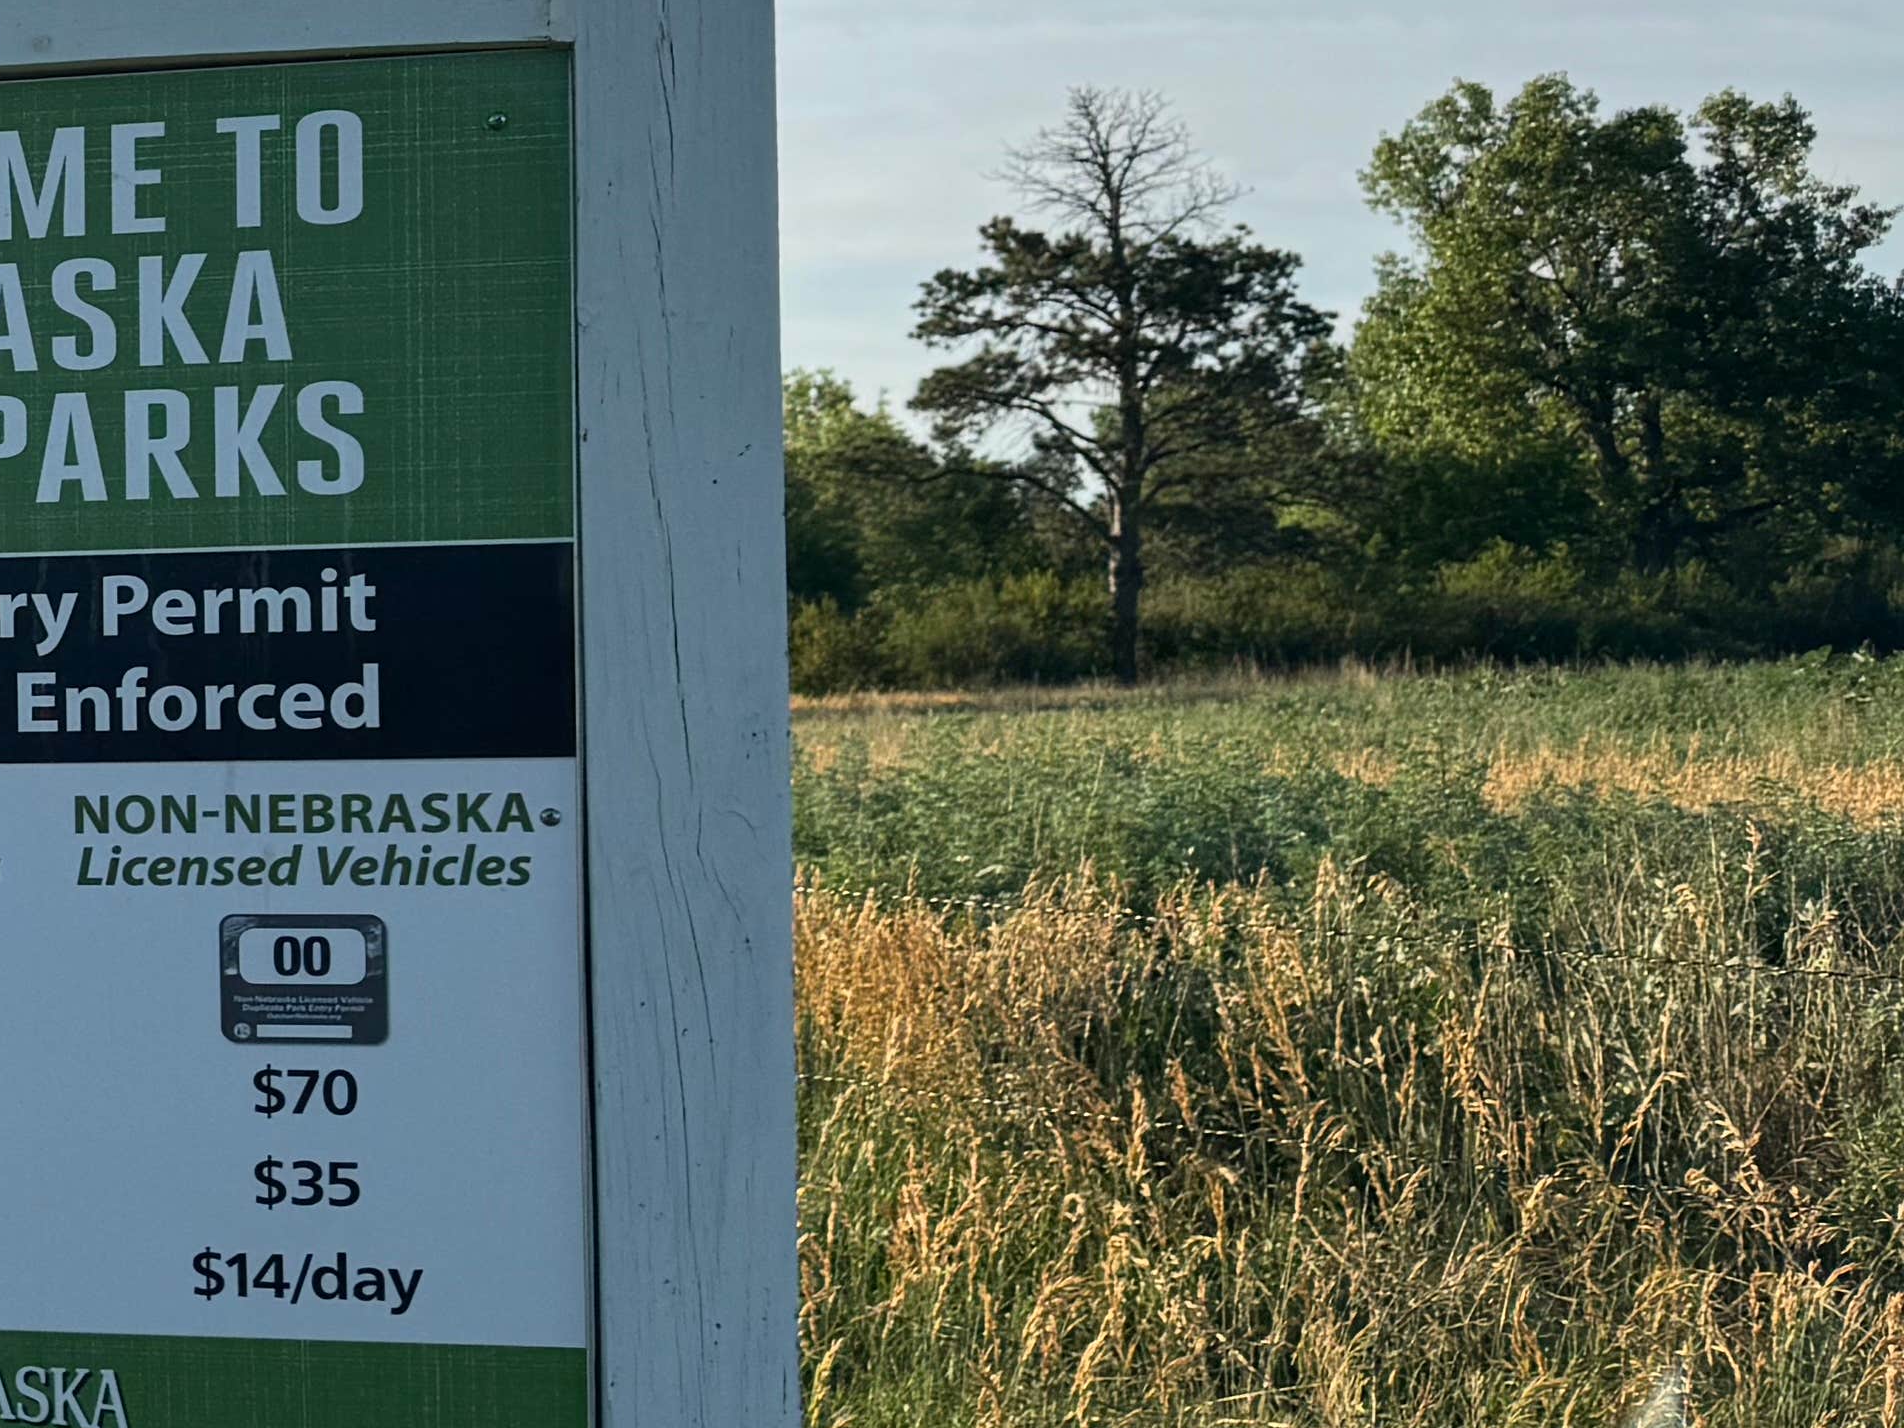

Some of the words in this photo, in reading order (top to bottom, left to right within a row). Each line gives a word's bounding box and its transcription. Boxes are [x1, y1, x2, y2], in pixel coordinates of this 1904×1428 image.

[216, 111, 362, 226] TO
[103, 570, 375, 634] Permit
[17, 665, 379, 731] Enforced
[74, 793, 534, 833] NON-NEBRASKA
[77, 845, 303, 885] Licensed
[317, 844, 531, 885] Vehicles
[272, 934, 332, 978] 00
[253, 1066, 357, 1117] $70
[254, 1157, 359, 1208] $35
[193, 1250, 423, 1313] $14/day
